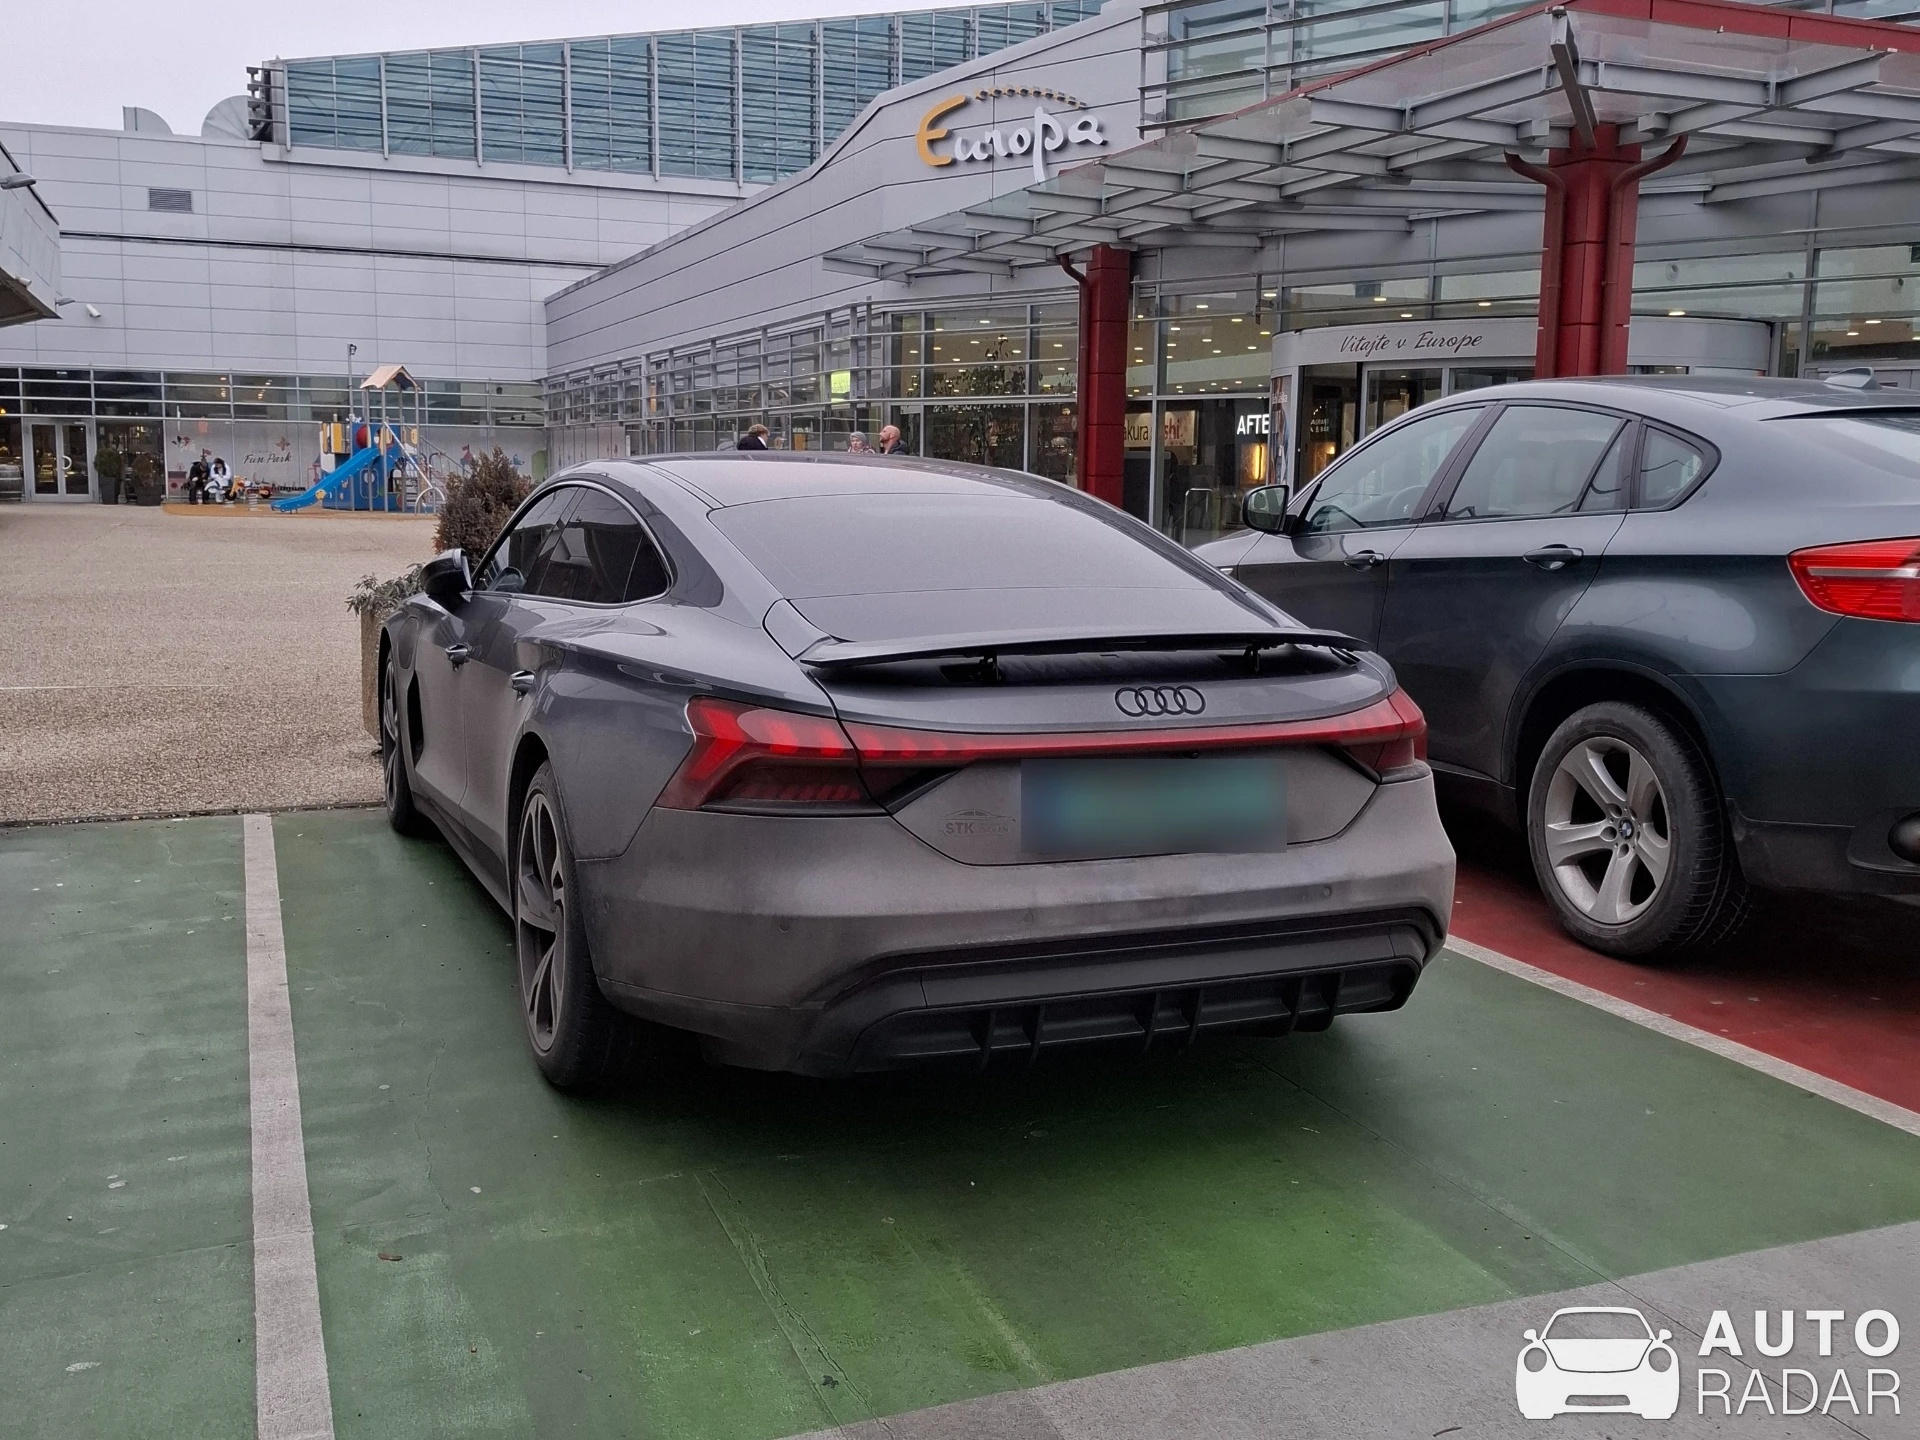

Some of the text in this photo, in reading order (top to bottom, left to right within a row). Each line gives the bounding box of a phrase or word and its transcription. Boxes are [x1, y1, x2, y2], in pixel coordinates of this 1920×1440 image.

[916, 94, 1104, 184] Europa
[1340, 331, 1482, 357] Vitajte v Europe
[1237, 414, 1270, 435] AFTE
[244, 452, 292, 464] Fun Park
[945, 822, 974, 834] STK
